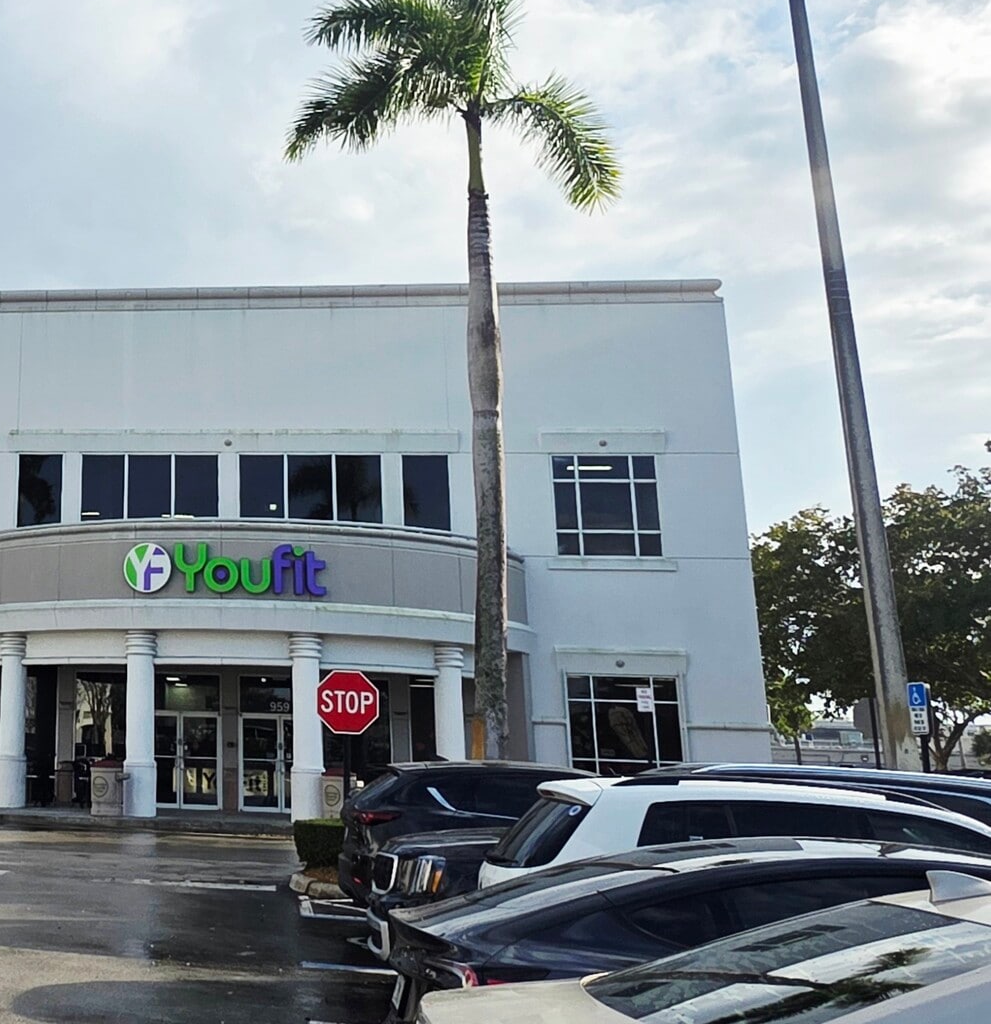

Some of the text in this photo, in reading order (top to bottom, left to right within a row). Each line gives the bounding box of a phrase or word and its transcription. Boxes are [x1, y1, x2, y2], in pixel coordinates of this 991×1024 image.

[174, 543, 327, 596] Youfit
[269, 701, 290, 712] 959
[320, 689, 374, 714] STOP
